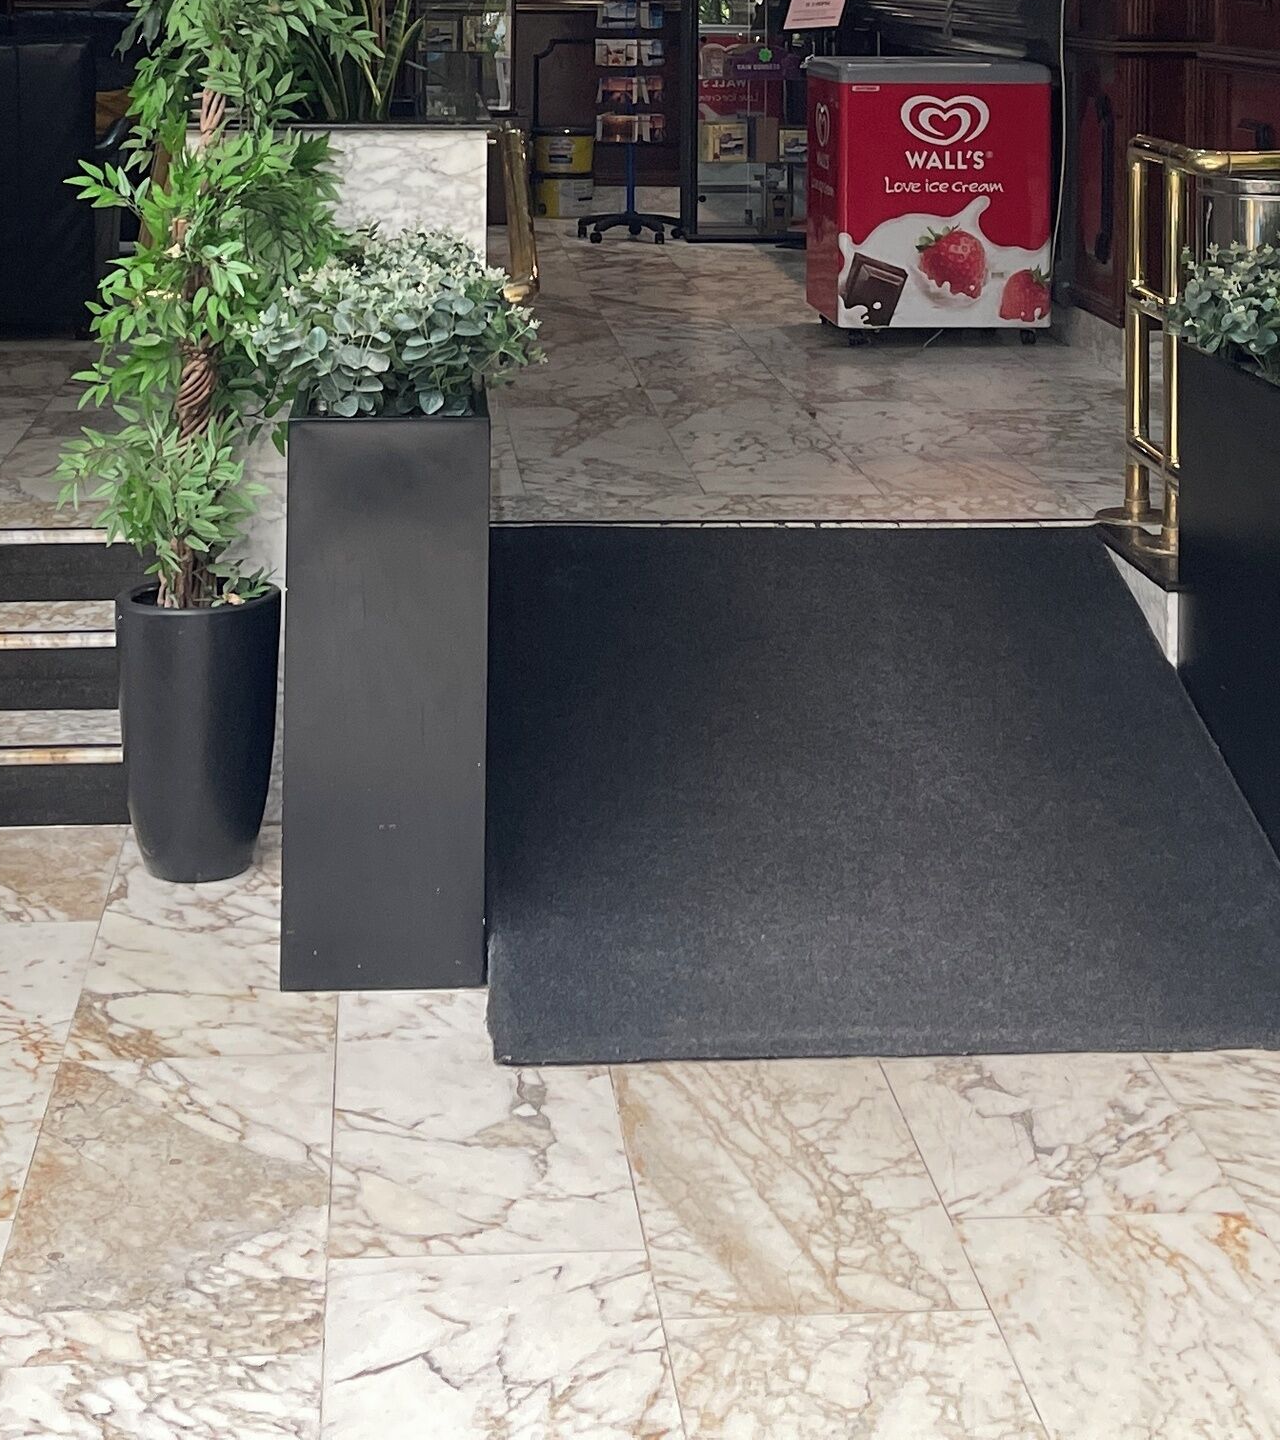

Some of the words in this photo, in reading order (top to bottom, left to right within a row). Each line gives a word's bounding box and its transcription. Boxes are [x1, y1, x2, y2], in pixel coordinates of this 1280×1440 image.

[905, 150, 985, 170] WALL'S
[884, 175, 922, 193] Love
[925, 178, 949, 193] ice
[951, 180, 1004, 193] cream
